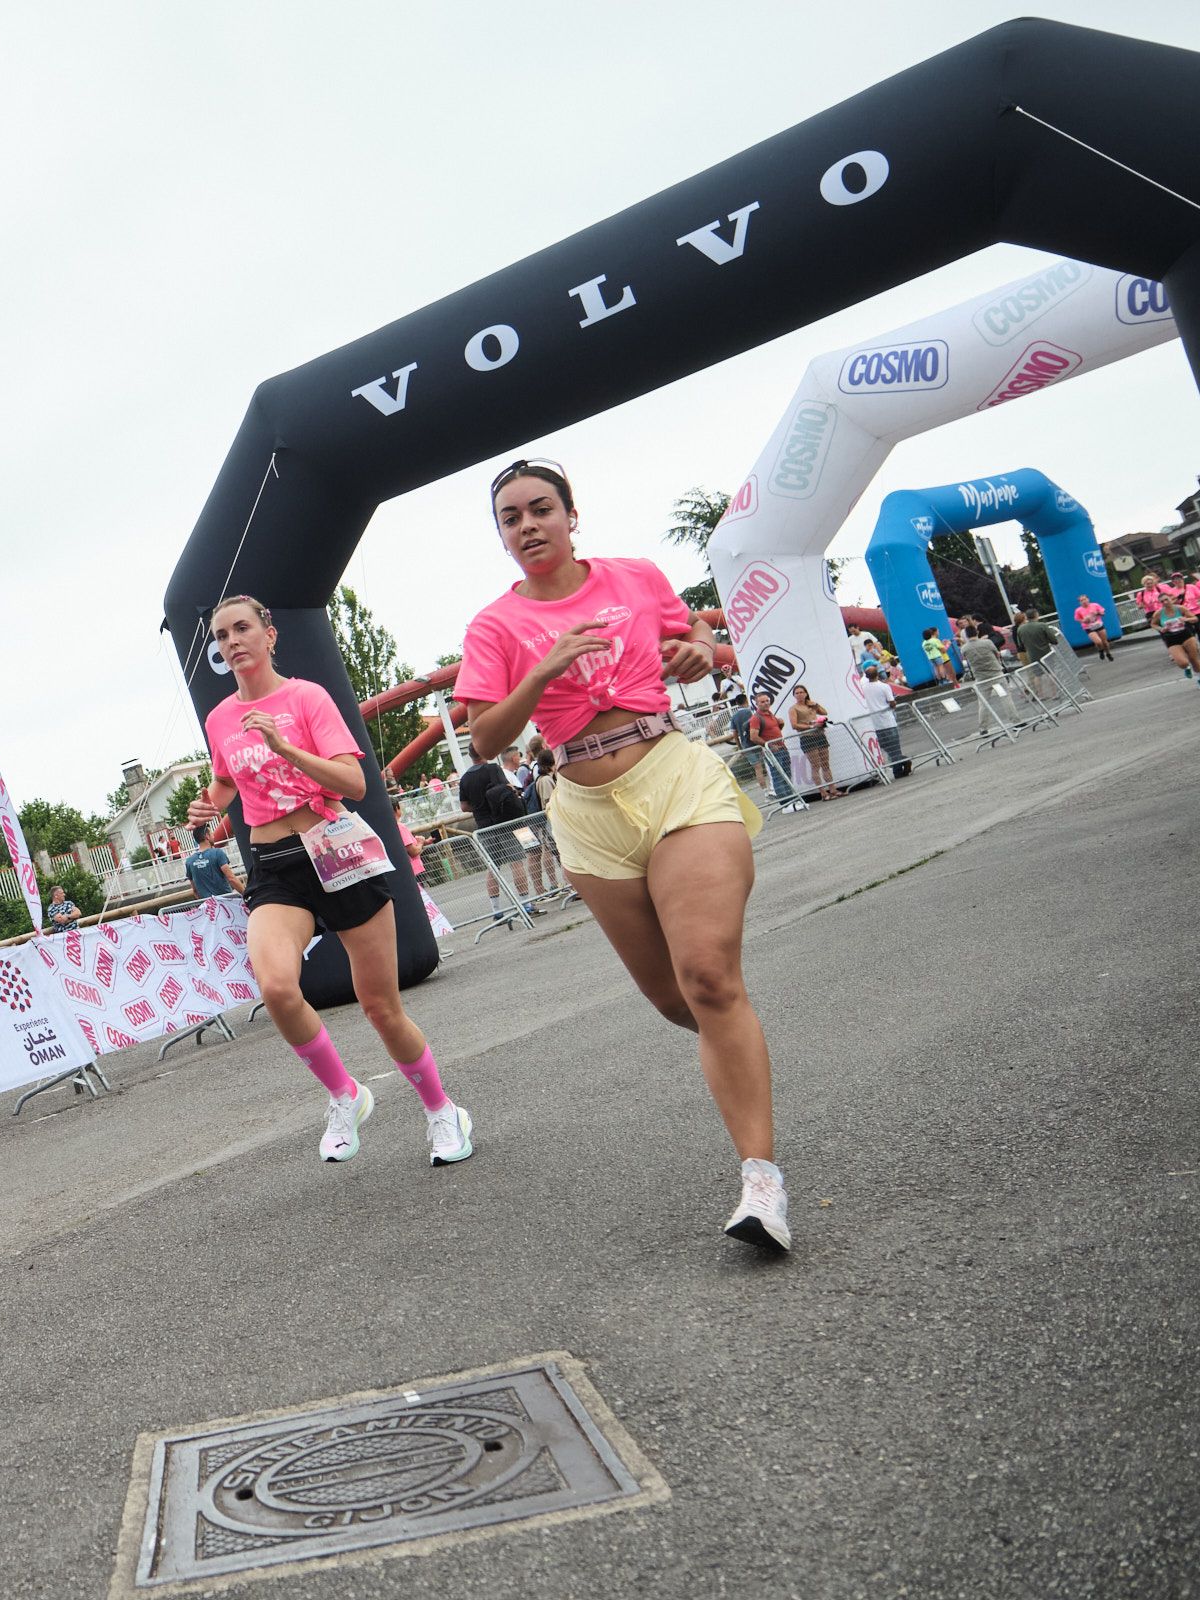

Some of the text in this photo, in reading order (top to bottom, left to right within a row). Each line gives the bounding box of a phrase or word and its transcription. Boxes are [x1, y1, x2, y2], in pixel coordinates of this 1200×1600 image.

[351, 150, 889, 416] VOLVO
[983, 261, 1081, 336] COSMO
[848, 345, 939, 386] COSMO
[775, 404, 829, 492] COSMO
[958, 479, 1019, 520] Marlene
[337, 841, 363, 859] 016
[332, 873, 357, 888] OYSHO
[95, 947, 114, 988] COSMO
[127, 949, 151, 982] COSMO
[154, 943, 186, 961] COSMO
[64, 977, 103, 1006] COSMO
[160, 976, 183, 1009] COSMO
[227, 983, 255, 1000] COSMO
[13, 1017, 49, 1032] Experience
[125, 1000, 156, 1027] COSMO
[29, 1044, 66, 1065] OMAN
[304, 1484, 476, 1529] GIJON
